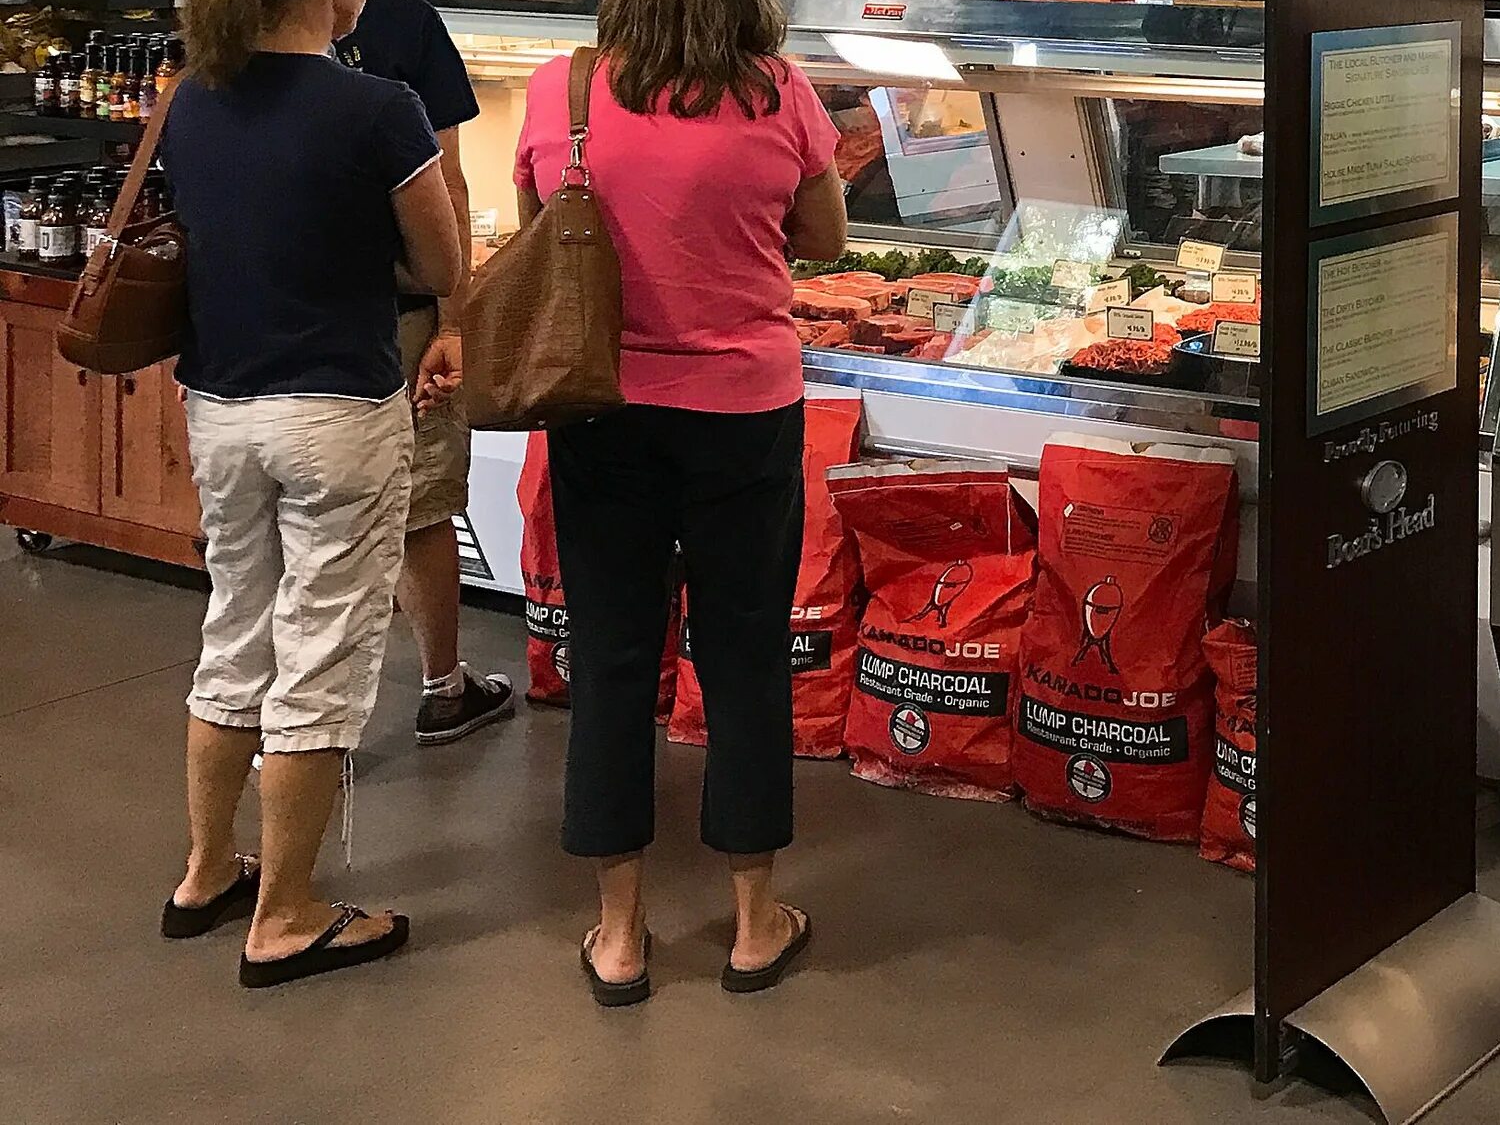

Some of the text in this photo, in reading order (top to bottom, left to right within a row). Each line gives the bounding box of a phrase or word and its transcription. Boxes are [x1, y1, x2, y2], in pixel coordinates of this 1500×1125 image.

[1385, 493, 1435, 543] Head
[860, 673, 990, 710] Restaurant Grade Organic
[861, 653, 992, 695] LUMP CHARCOAL
[1026, 700, 1170, 743] LUMP CHARCOAL
[1026, 721, 1171, 759] Restaurant Grade Organic
